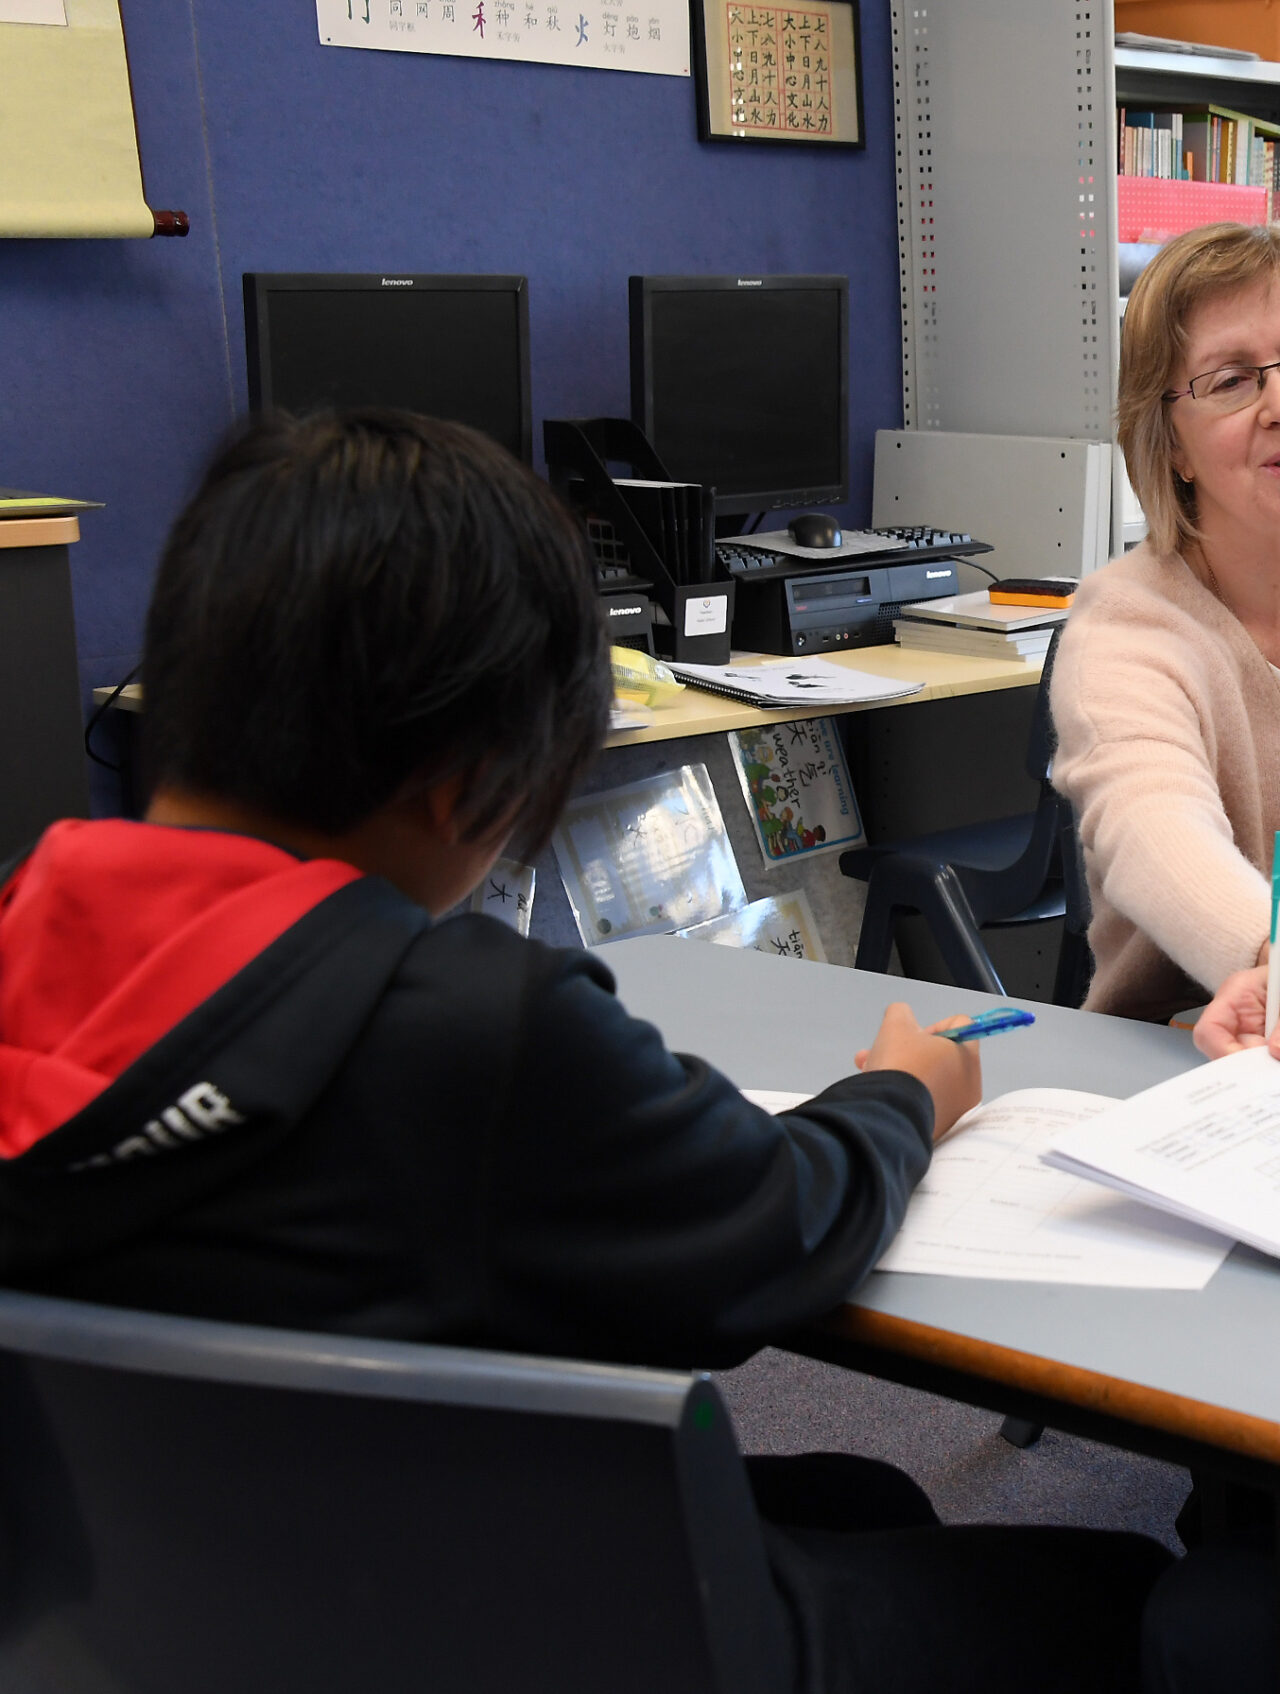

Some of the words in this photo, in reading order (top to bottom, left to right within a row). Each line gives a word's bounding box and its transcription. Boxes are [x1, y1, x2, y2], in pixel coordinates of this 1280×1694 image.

[472, 1, 486, 39] 禾
[524, 13, 538, 30] 和
[547, 15, 561, 31] 秋
[575, 14, 588, 47] 火
[604, 20, 616, 37] 灯
[382, 278, 414, 286] lenovo
[609, 607, 642, 616] lenovo
[785, 721, 807, 746] 天
[799, 762, 818, 787] 气
[773, 733, 800, 808] weather
[831, 764, 849, 816] learning
[488, 879, 513, 903] 大
[770, 937, 791, 956] 天
